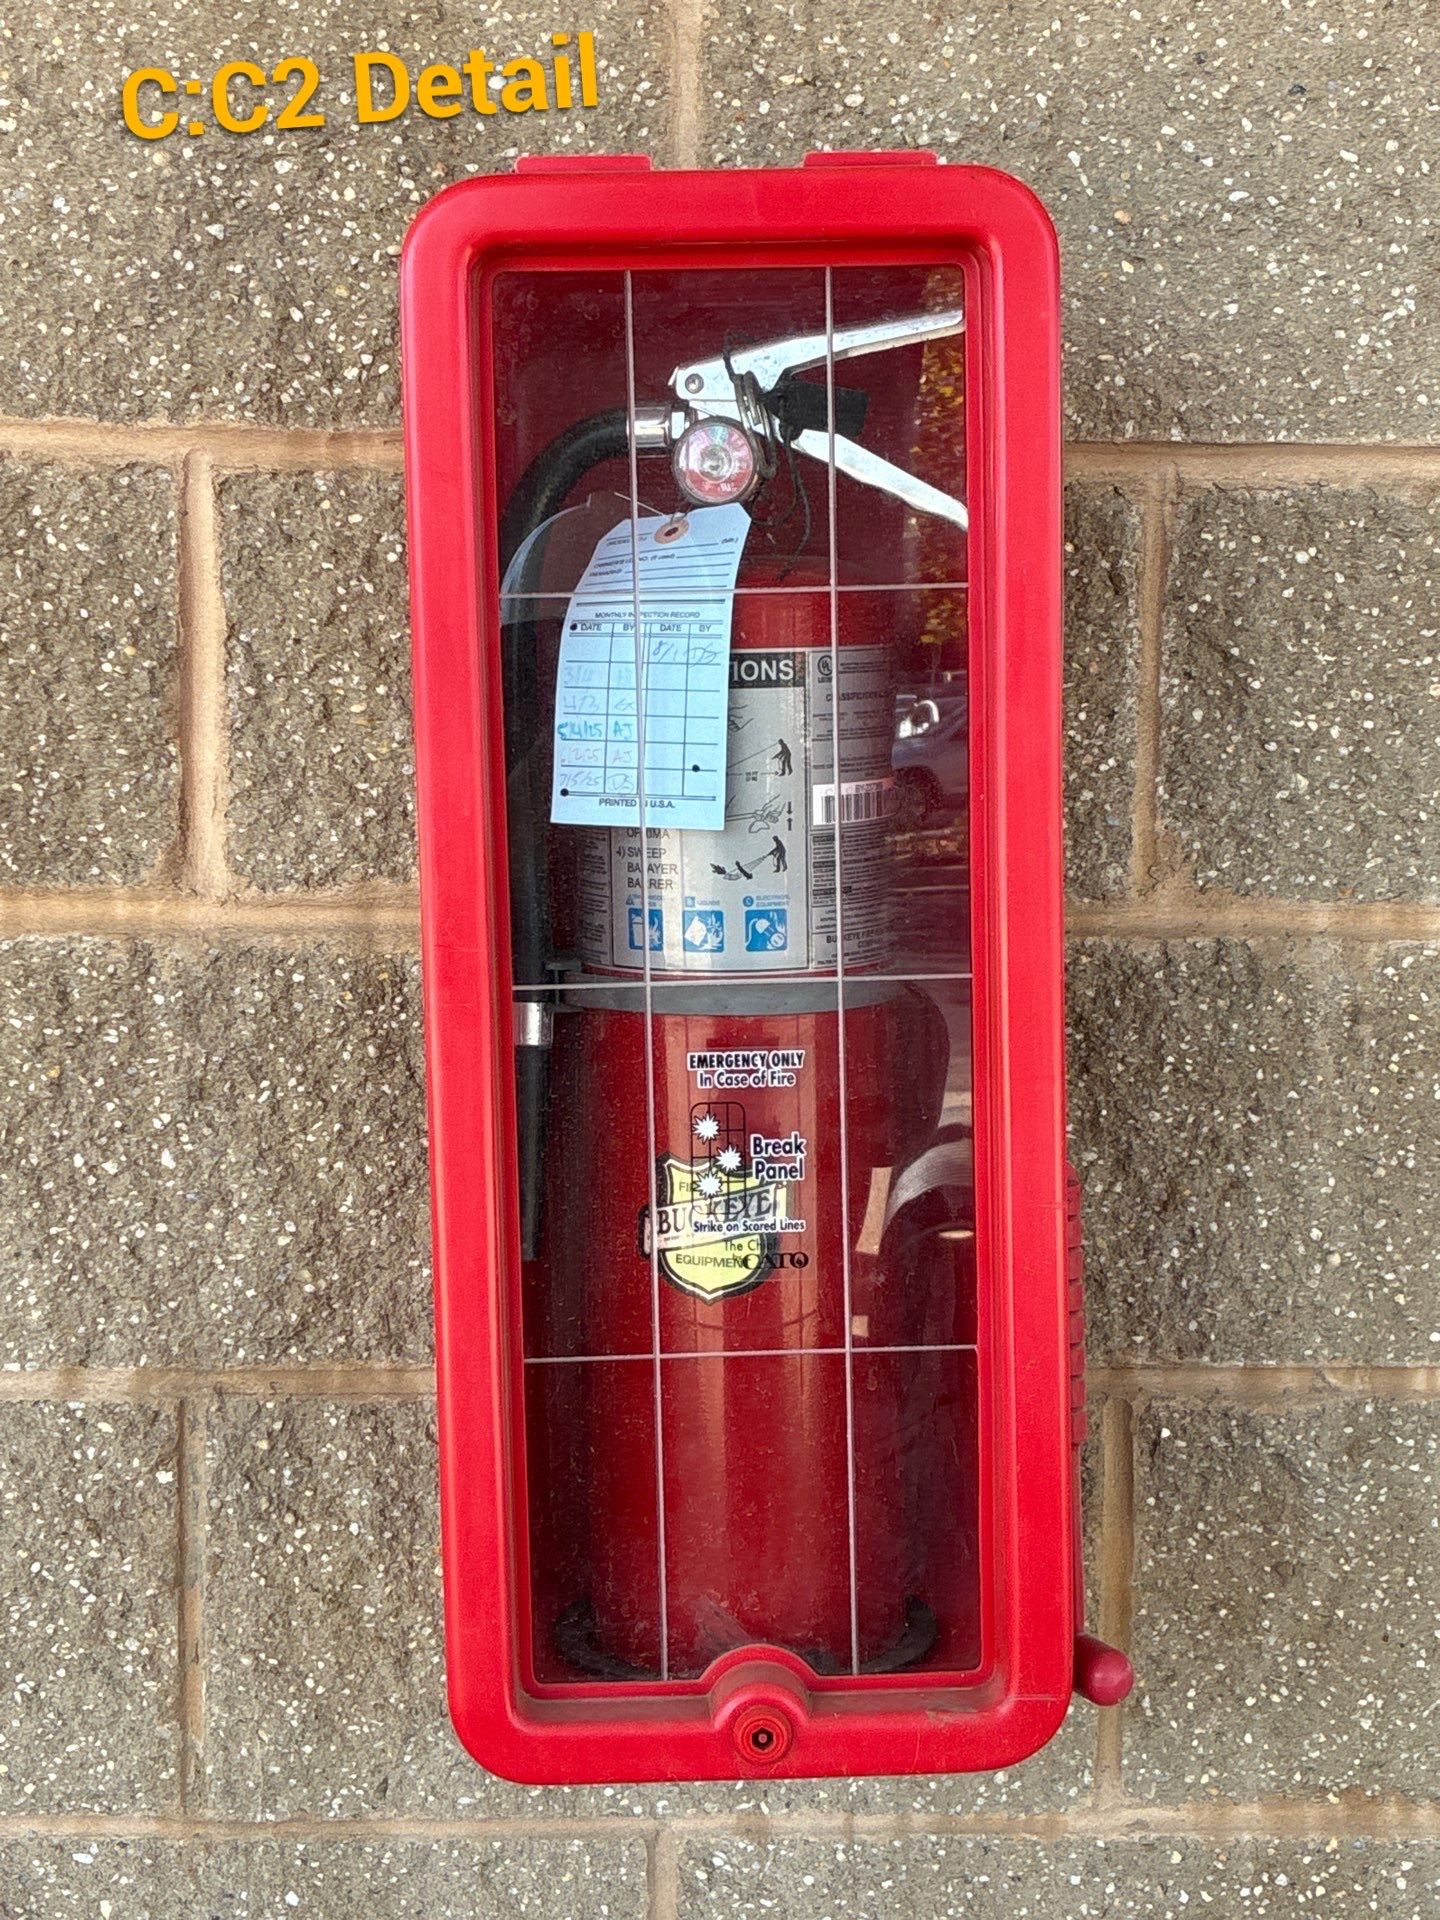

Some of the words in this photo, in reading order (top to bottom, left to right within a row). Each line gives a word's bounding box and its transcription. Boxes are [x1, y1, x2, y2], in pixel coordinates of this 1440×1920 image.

[659, 624, 682, 632] DATE
[699, 624, 712, 632] BY
[599, 798, 637, 807] PRINTED
[650, 800, 676, 809] U.S.A.
[627, 863, 679, 875] BAAYER
[627, 877, 674, 890] BARER
[689, 1052, 767, 1069] EMERGENCY
[771, 1051, 804, 1067] ONLY
[699, 1072, 712, 1087] In
[716, 1071, 749, 1087] Case
[752, 1069, 768, 1086] of
[769, 1071, 795, 1085] Fire
[752, 1133, 805, 1155] Break
[754, 1158, 804, 1180] Panel
[693, 1220, 723, 1233] Strike
[726, 1221, 740, 1232] on
[742, 1219, 777, 1232] Scored
[779, 1218, 806, 1230] Lines
[724, 1239, 744, 1251] The
[747, 1238, 781, 1251] Chief
[742, 1251, 810, 1270] CATO
